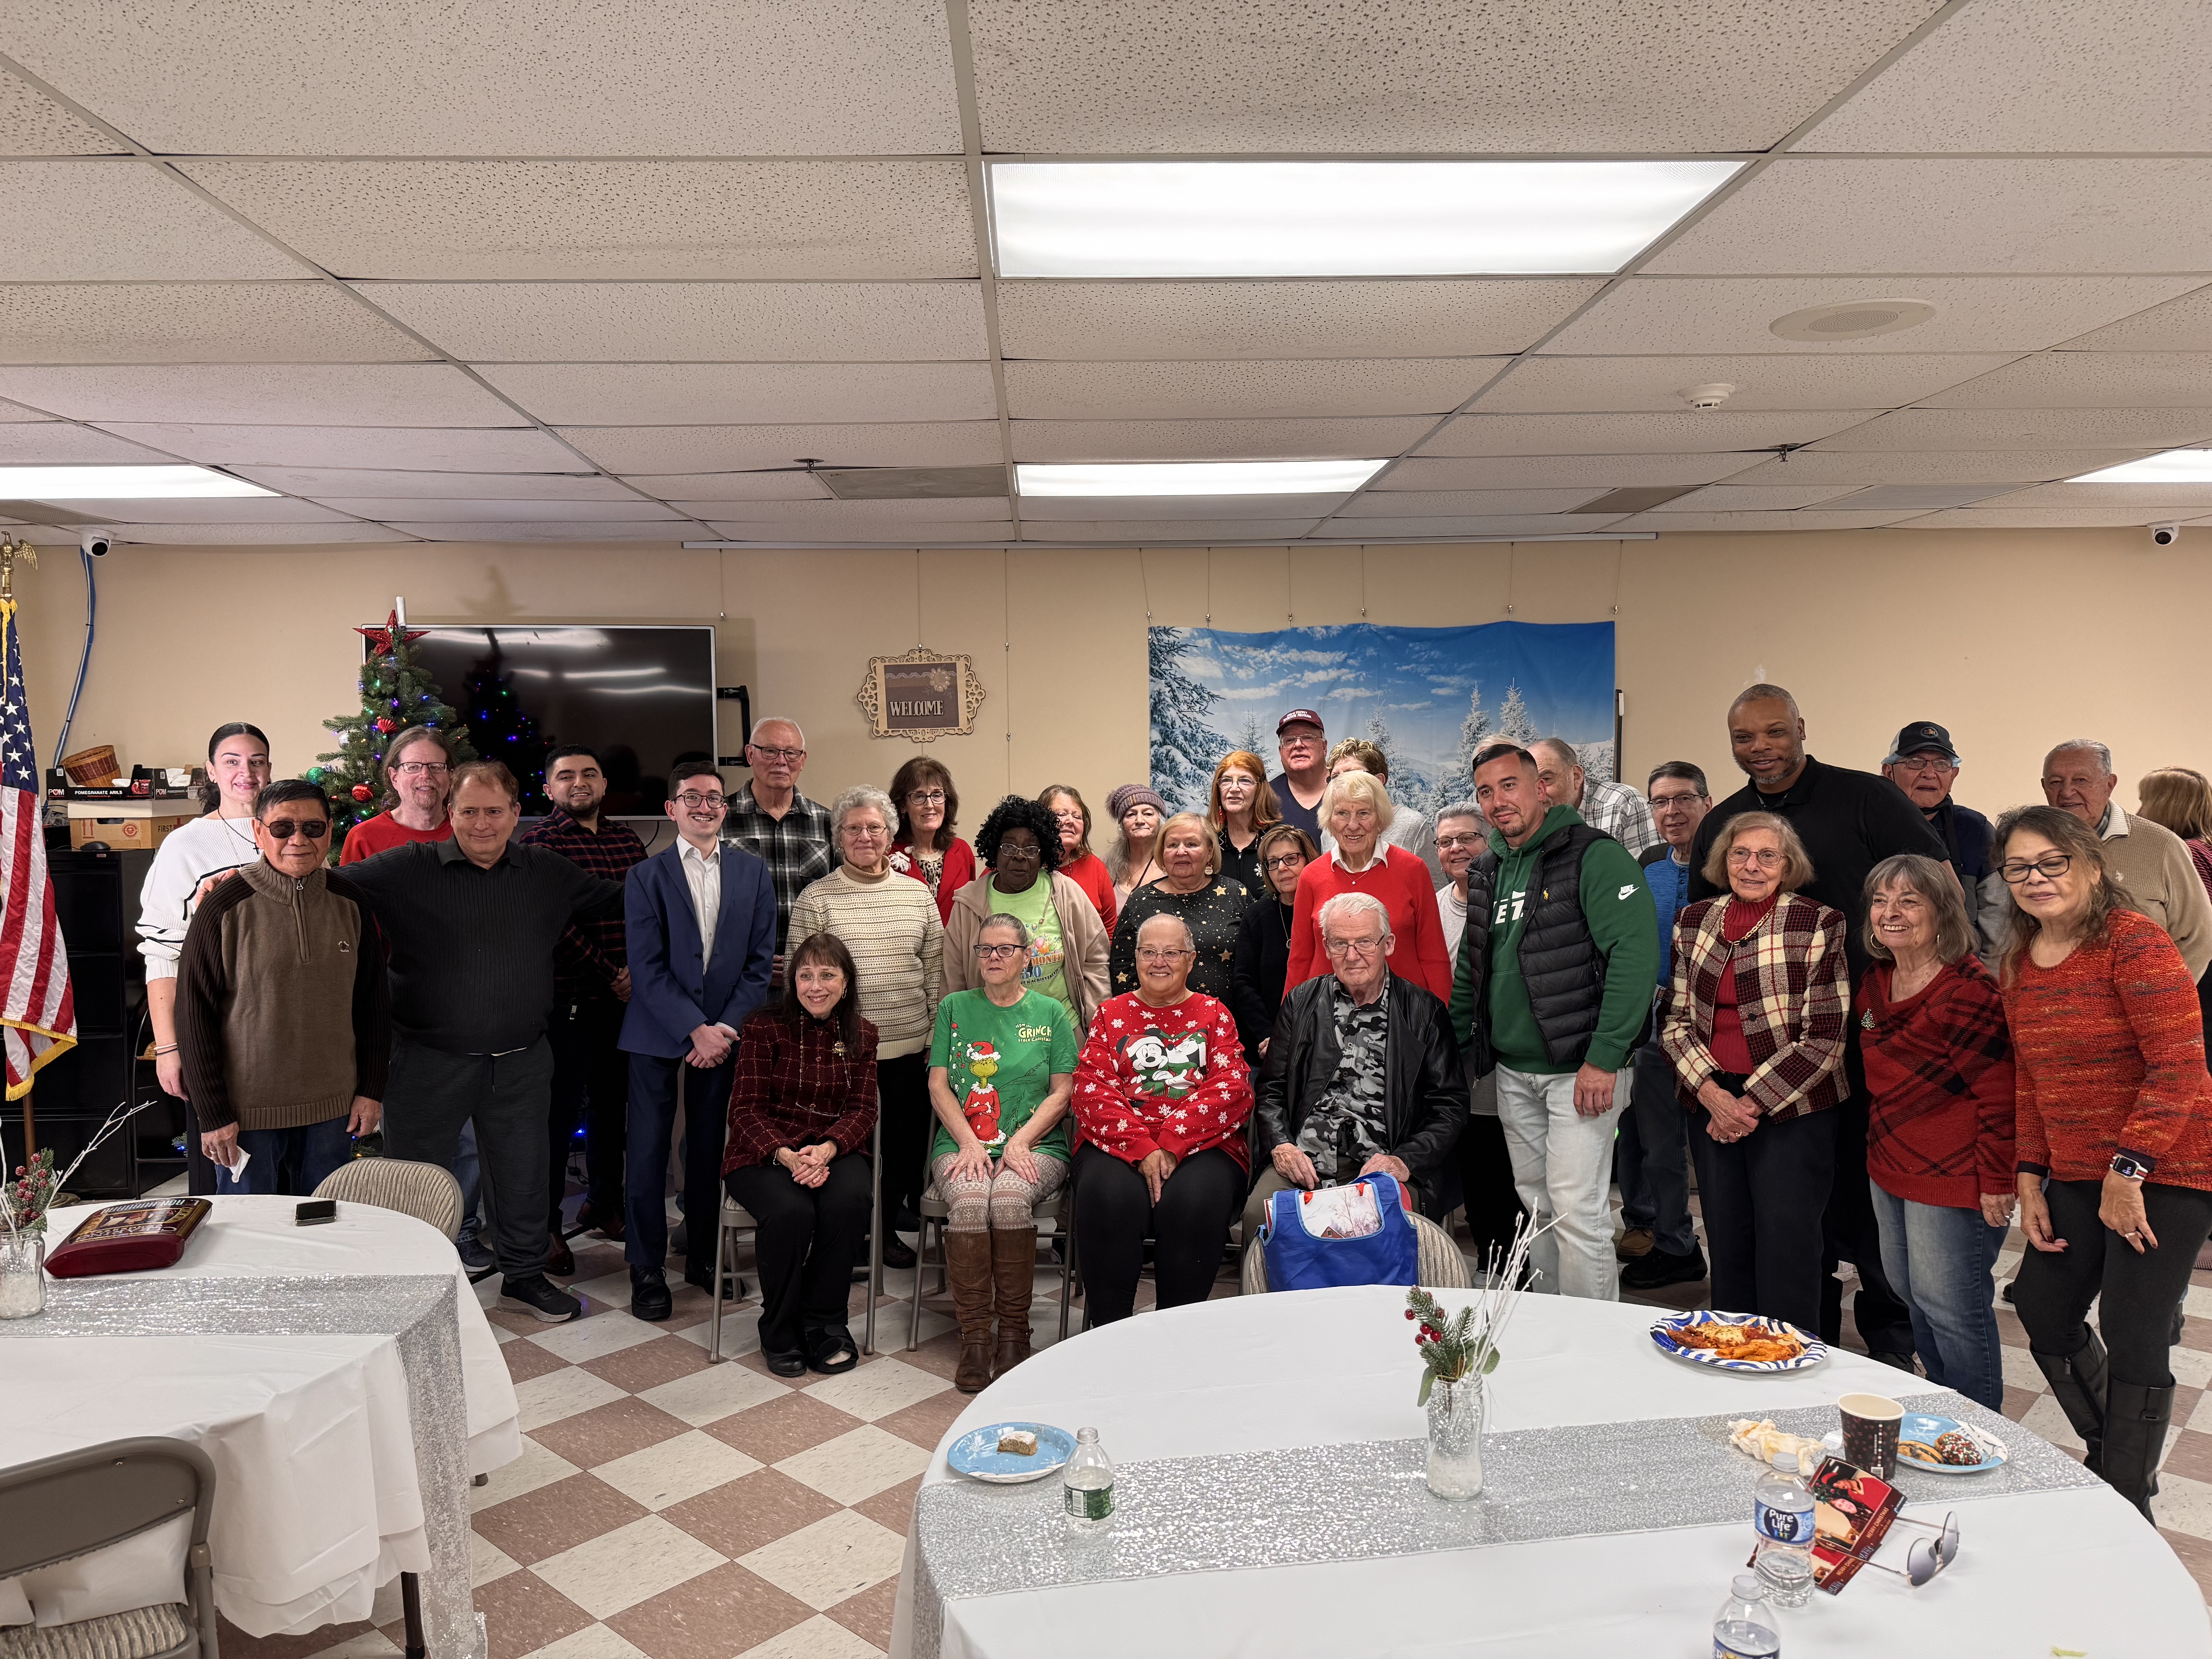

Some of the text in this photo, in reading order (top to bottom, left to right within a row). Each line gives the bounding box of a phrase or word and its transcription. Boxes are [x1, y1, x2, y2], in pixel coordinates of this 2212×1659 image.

[890, 700, 944, 716] WELCOME
[1620, 884, 1634, 894] NIKE
[1018, 1025, 1052, 1038] GRINCH
[100, 1202, 158, 1214] HUBBARD
[1769, 1509, 1794, 1522] Pure
[1772, 1518, 1791, 1532] Life
[1866, 1525, 1877, 1538] MERRY
[1874, 1507, 1889, 1526] CHRISTMAS
